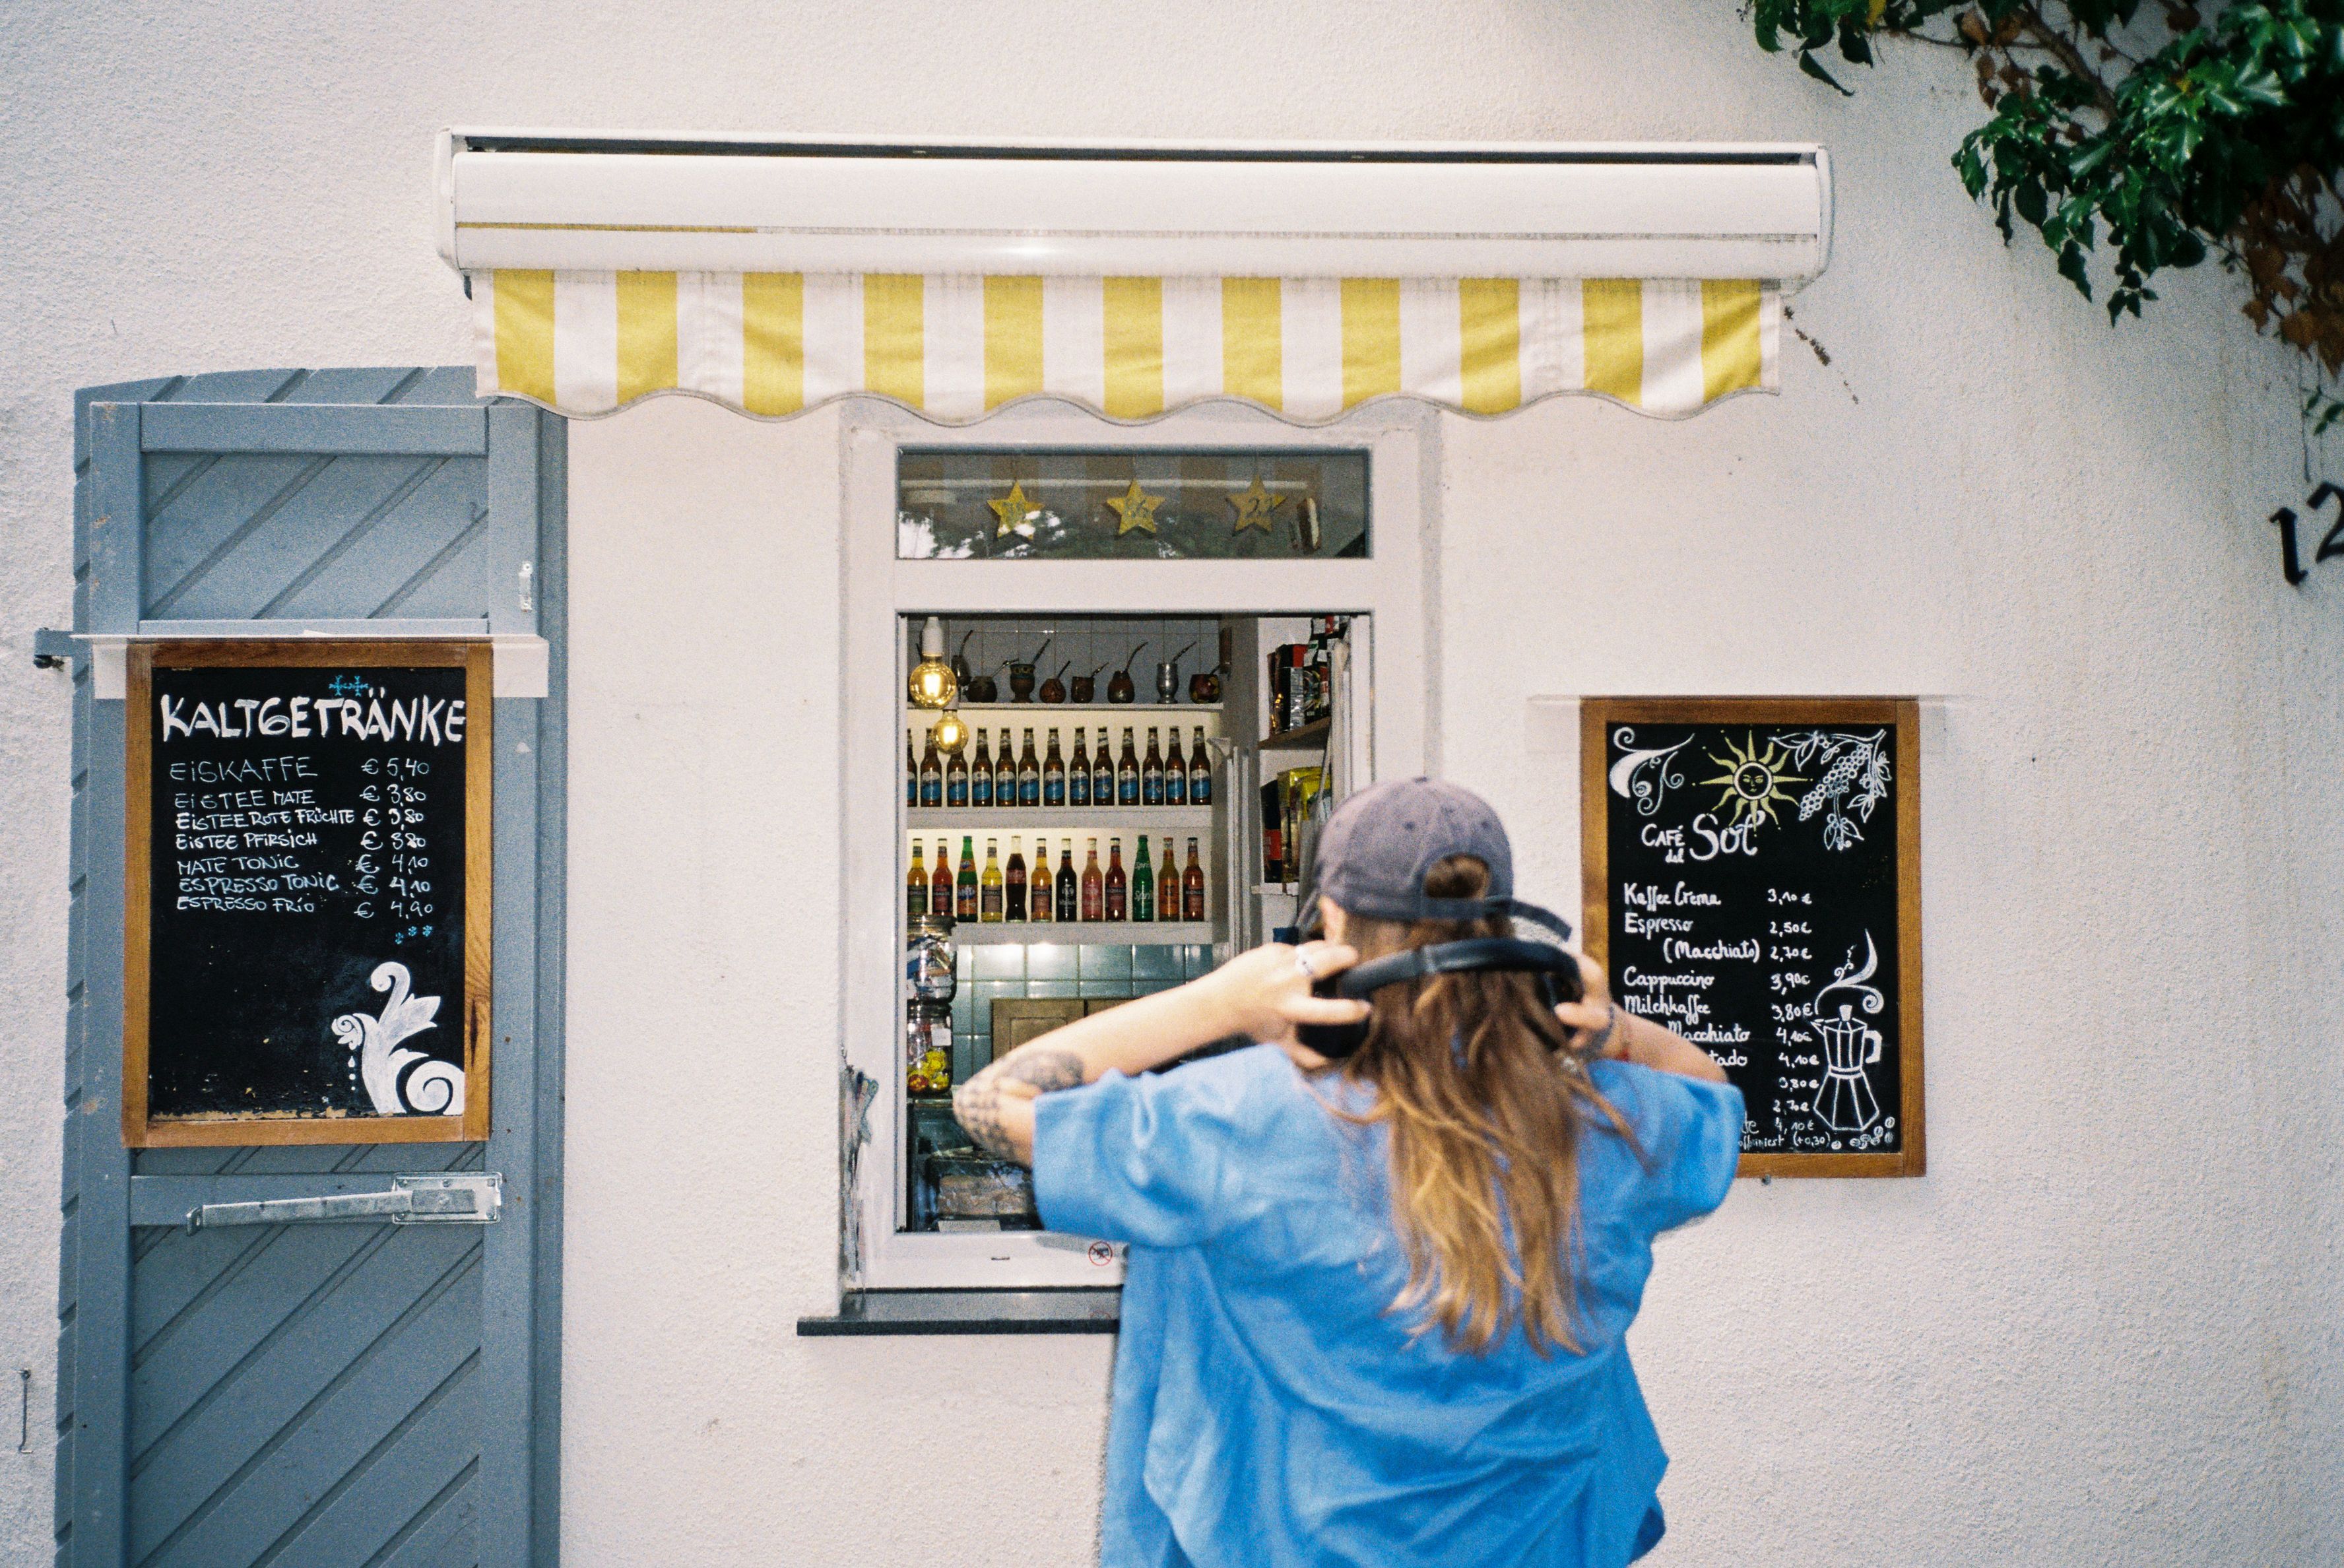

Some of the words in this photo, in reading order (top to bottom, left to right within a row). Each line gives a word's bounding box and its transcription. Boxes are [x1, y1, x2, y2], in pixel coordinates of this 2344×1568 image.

[160, 686, 466, 746] KALTGETRÄNKE
[362, 759, 378, 774] €
[387, 758, 428, 781] 5,40
[273, 790, 315, 805] MATE
[360, 785, 379, 801] €
[387, 784, 426, 806] 3,80
[363, 808, 380, 826] €
[360, 831, 383, 850] €
[178, 857, 226, 875] MATE
[356, 854, 379, 873] €
[392, 854, 428, 874] 4,10
[179, 877, 277, 895] ESPRESSO
[356, 875, 377, 894] €
[389, 876, 430, 898] 4,10
[1624, 883, 1671, 911] Kaffee
[1675, 881, 1721, 905] Crema
[1768, 888, 1797, 905] 3,10
[177, 896, 267, 911] ESPRESSO
[354, 902, 374, 918] €
[1625, 912, 1693, 941] Espresso
[1663, 938, 1760, 963] (Macchiato)
[1624, 966, 1714, 995] Cappuccino
[1623, 994, 1711, 1026] Milchkaffee
[1708, 1048, 1748, 1067] tado
